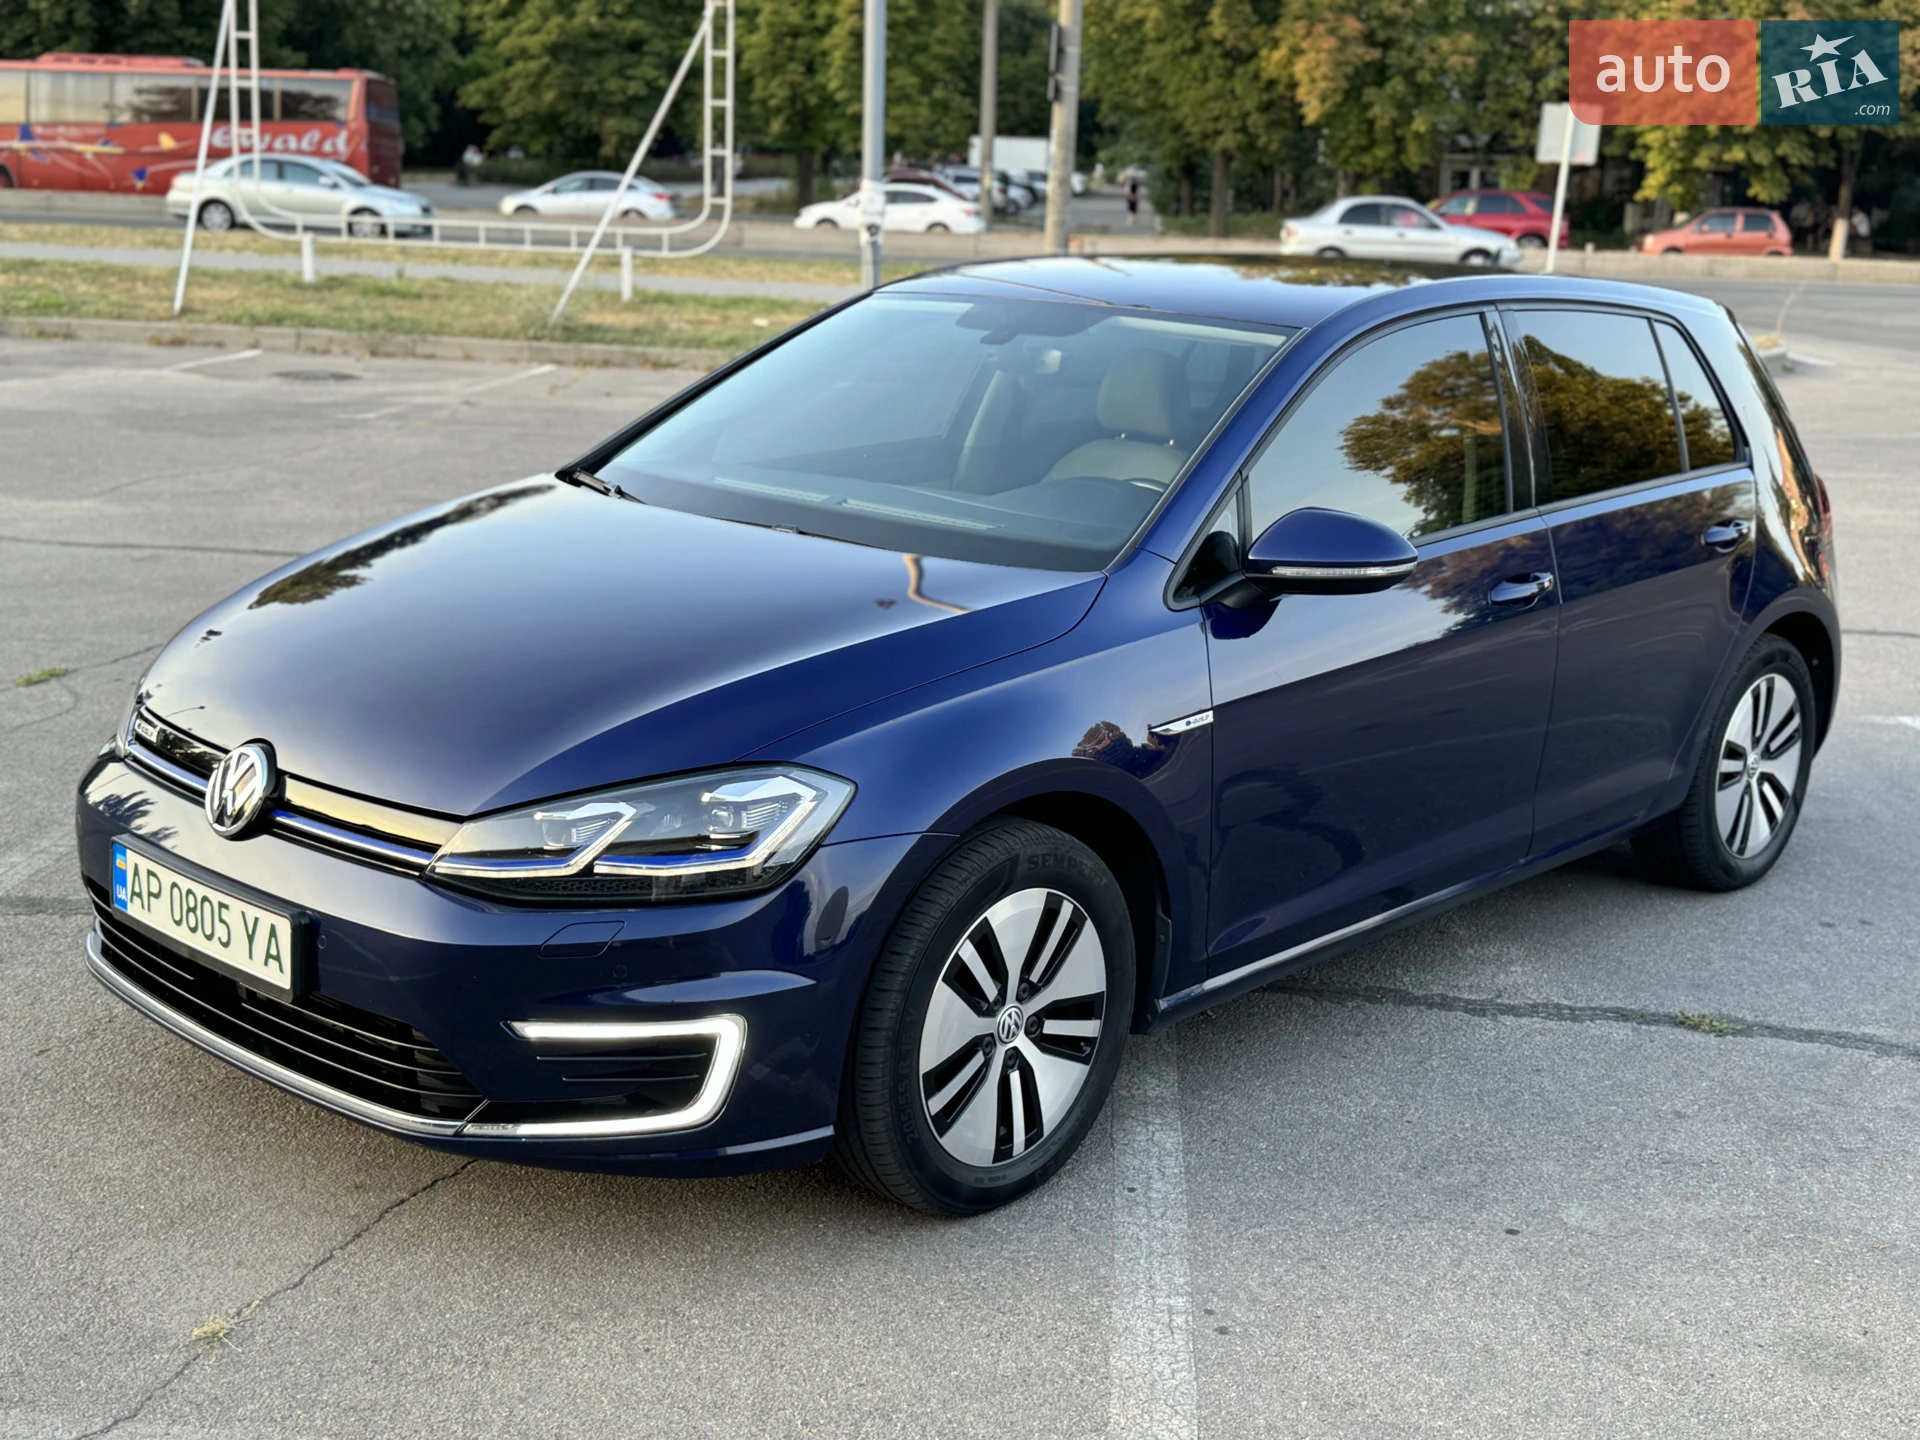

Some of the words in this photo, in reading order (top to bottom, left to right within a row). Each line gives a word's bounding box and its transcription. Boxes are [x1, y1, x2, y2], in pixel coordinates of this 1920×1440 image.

[1027, 852, 1109, 886] SEMPE
[116, 883, 128, 902] UA
[130, 862, 162, 913] AP
[169, 881, 231, 948] 0805
[241, 910, 285, 974] YA
